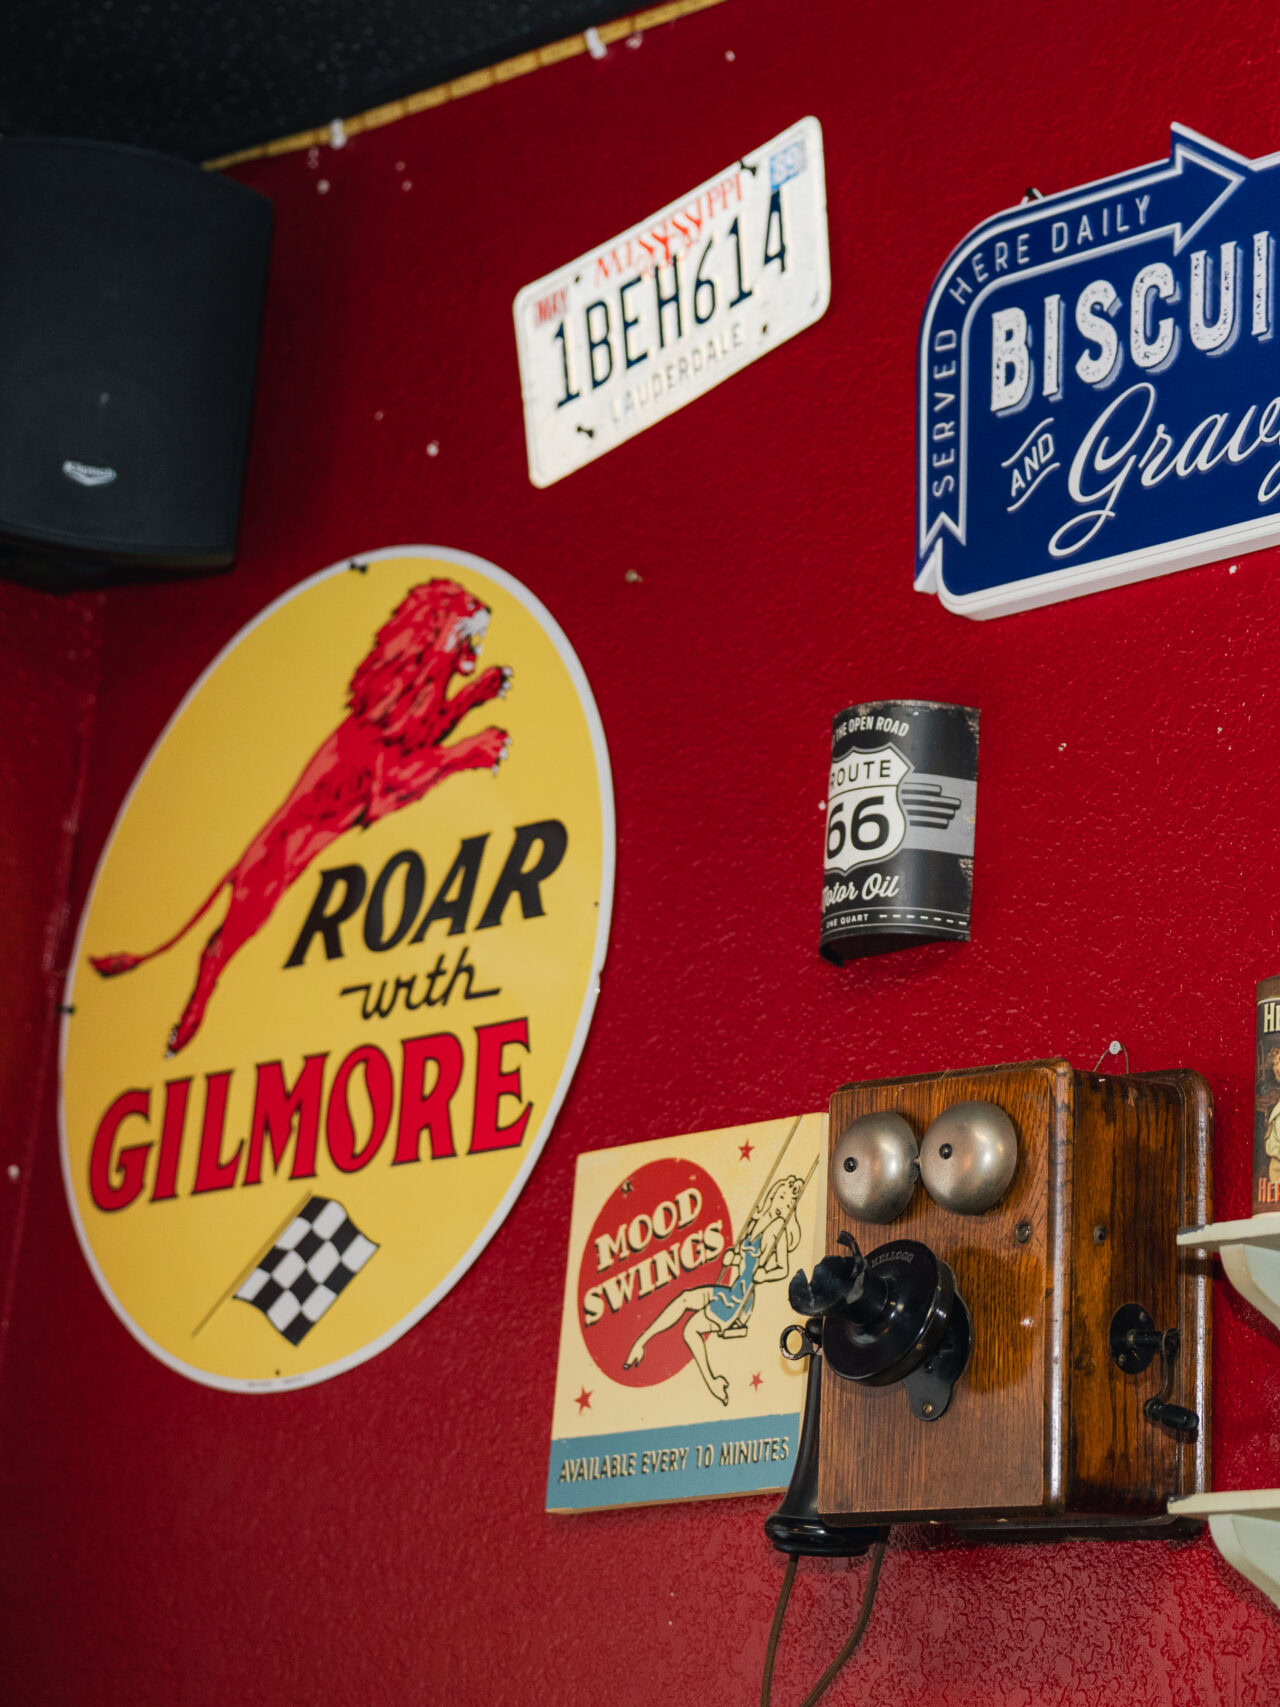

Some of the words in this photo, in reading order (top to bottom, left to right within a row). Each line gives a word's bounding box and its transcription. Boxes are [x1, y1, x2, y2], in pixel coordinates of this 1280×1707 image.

[555, 190, 787, 408] 1BEH614
[612, 322, 745, 424] LAUDERDALE
[932, 328, 957, 499] SERVED
[949, 242, 1031, 306] HERE
[1051, 194, 1152, 255] DAILY
[1010, 431, 1055, 499] AND
[848, 715, 875, 733] OPEN
[875, 716, 910, 737] ROAD
[827, 795, 890, 860] 66
[283, 819, 568, 968] ROAR
[840, 913, 869, 925] QUART
[862, 872, 901, 901] Oil
[339, 945, 501, 1021] with
[88, 1016, 534, 1214] GILMORE
[593, 1187, 703, 1272] MOOD
[583, 1219, 726, 1328] SWINGS
[558, 1452, 638, 1484] AVAILABLE
[641, 1446, 690, 1474] EVERY
[696, 1443, 715, 1469] 10
[719, 1436, 790, 1467] MINUTES
